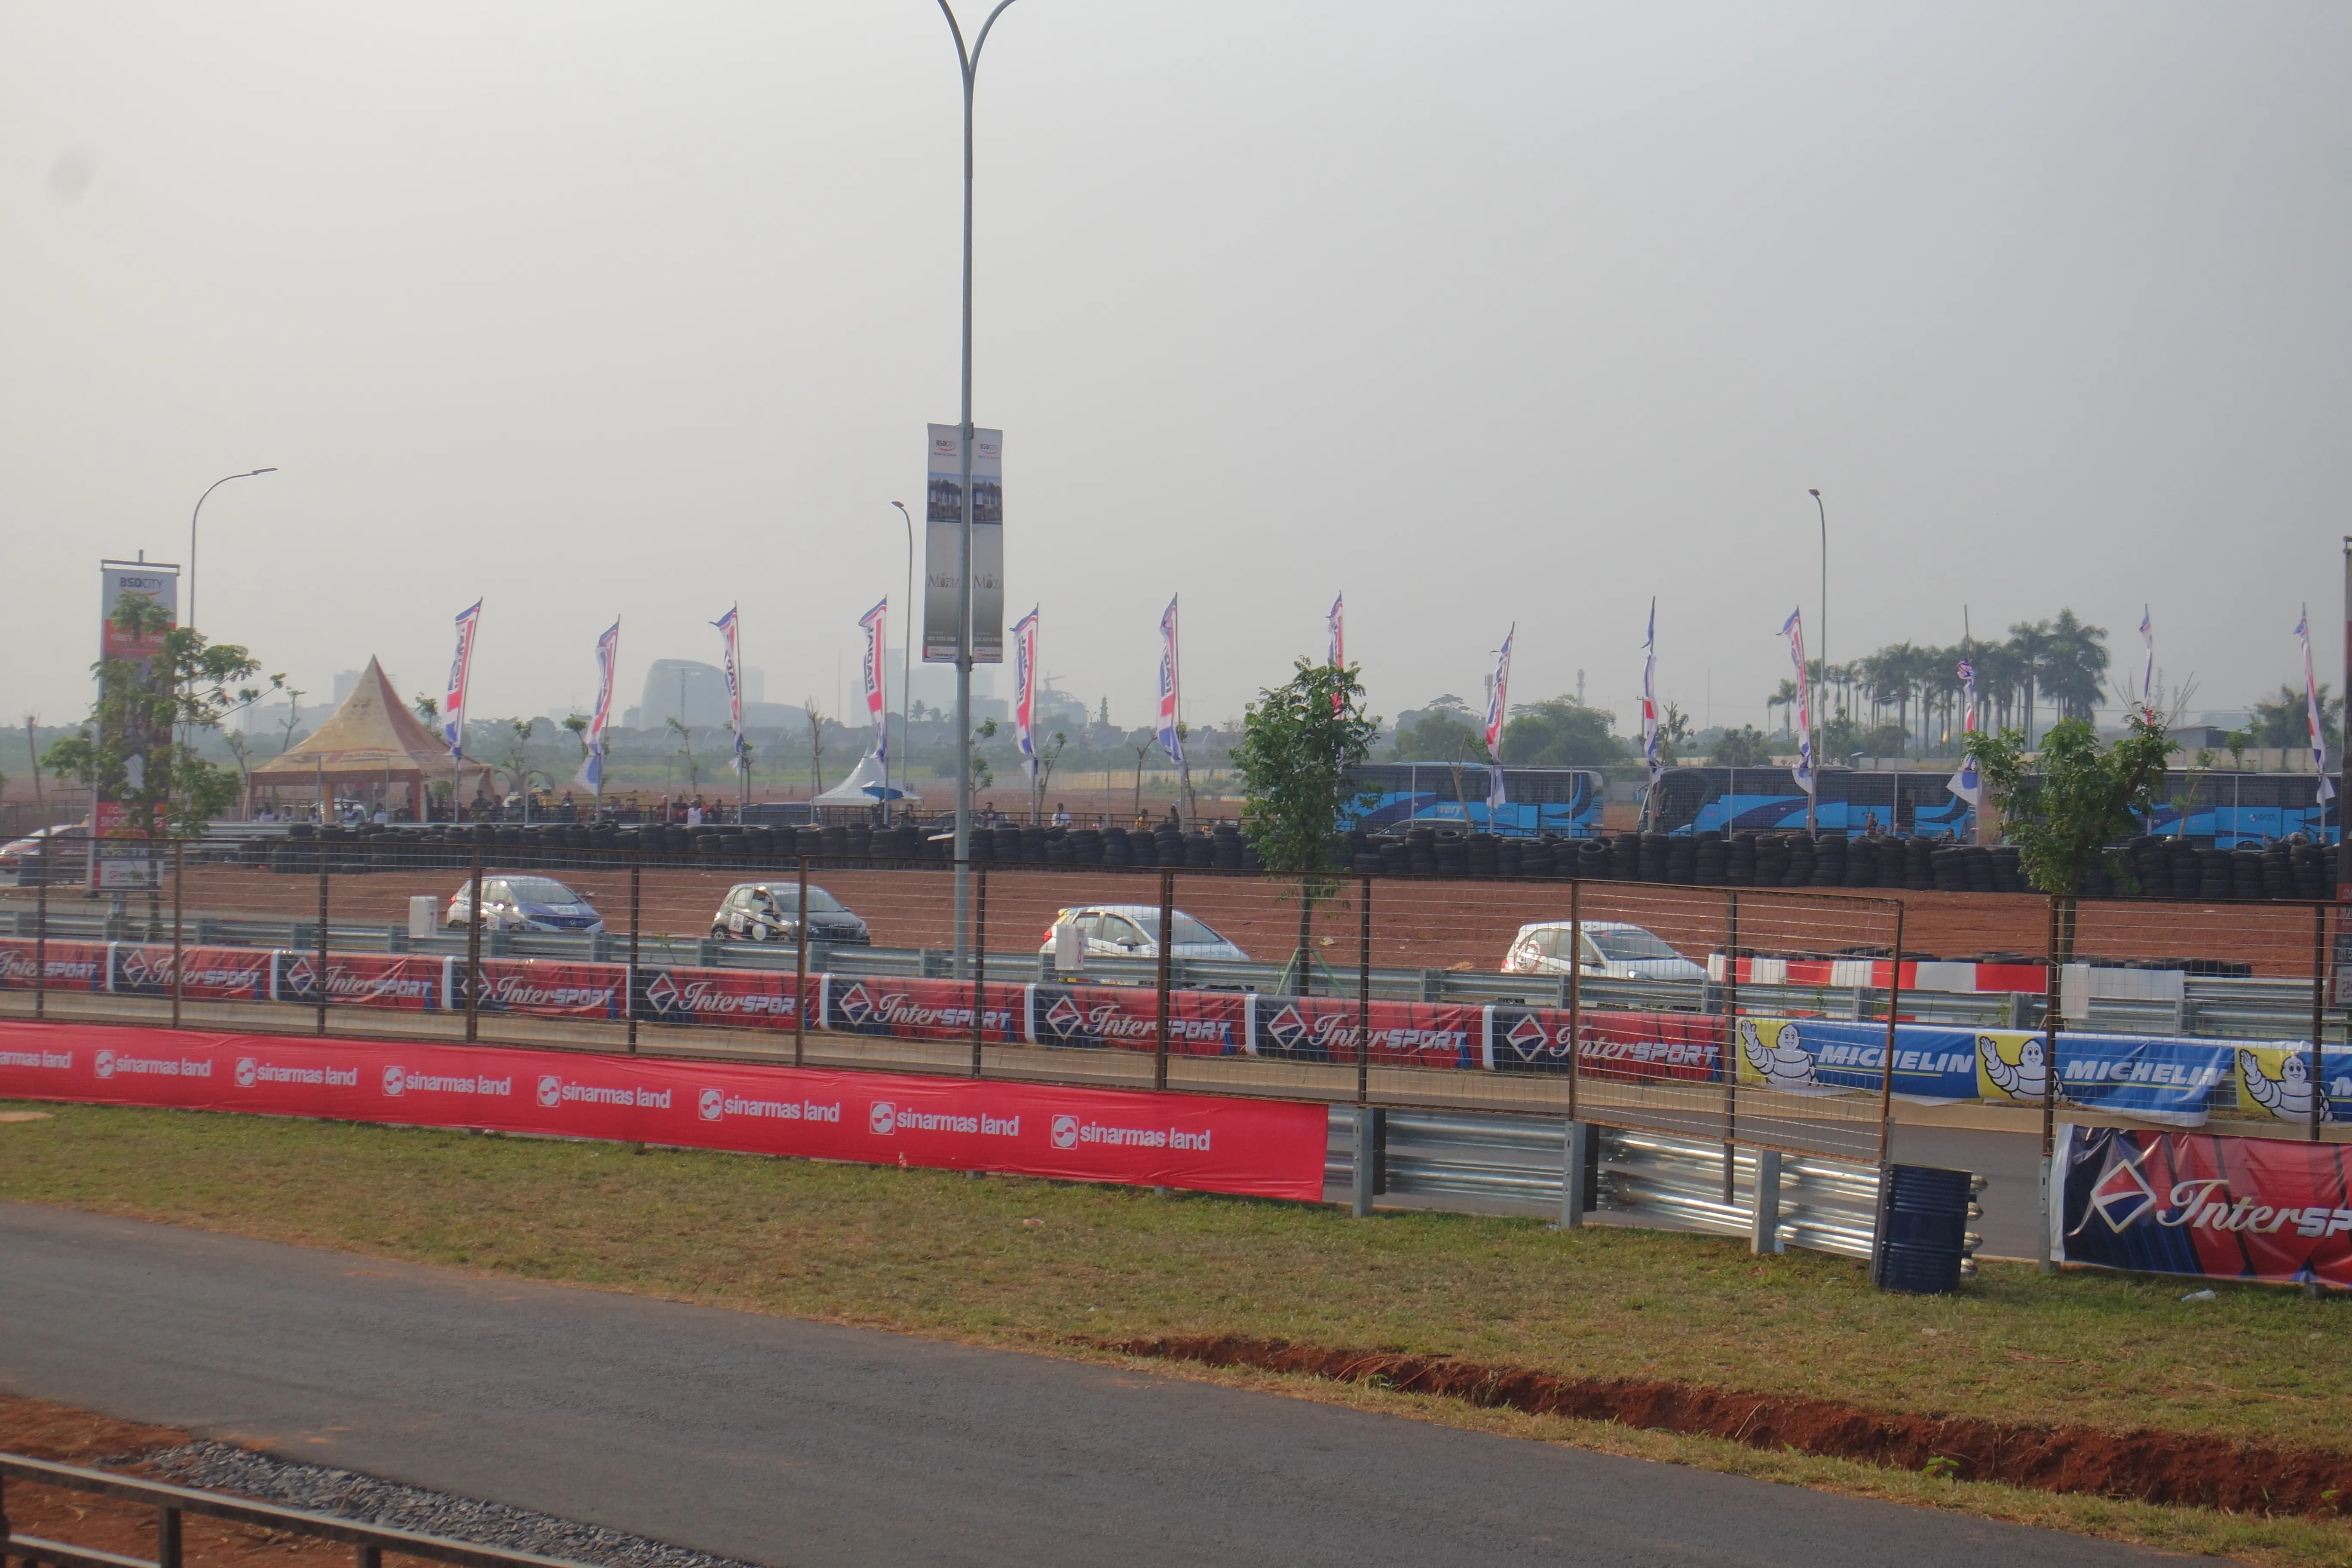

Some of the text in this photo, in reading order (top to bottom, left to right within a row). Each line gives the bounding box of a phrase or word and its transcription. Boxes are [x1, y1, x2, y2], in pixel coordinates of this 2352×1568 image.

[0, 950, 97, 978] InteSPORT
[488, 976, 614, 1006] InterSPORT
[678, 981, 808, 1015] InterSPOR
[1083, 1005, 1231, 1040] InterPORT
[1308, 1014, 1467, 1051] IntrSPORT
[42, 1050, 72, 1069] land
[116, 1054, 211, 1077] sinarmas land
[257, 1063, 357, 1086] sinarmas land
[405, 1071, 511, 1096] sinarmas land
[562, 1081, 671, 1109] sinarmas land
[724, 1094, 839, 1122] sinarmas land
[897, 1107, 1019, 1136] sinarmas land
[1080, 1121, 1210, 1151] sinarmas land
